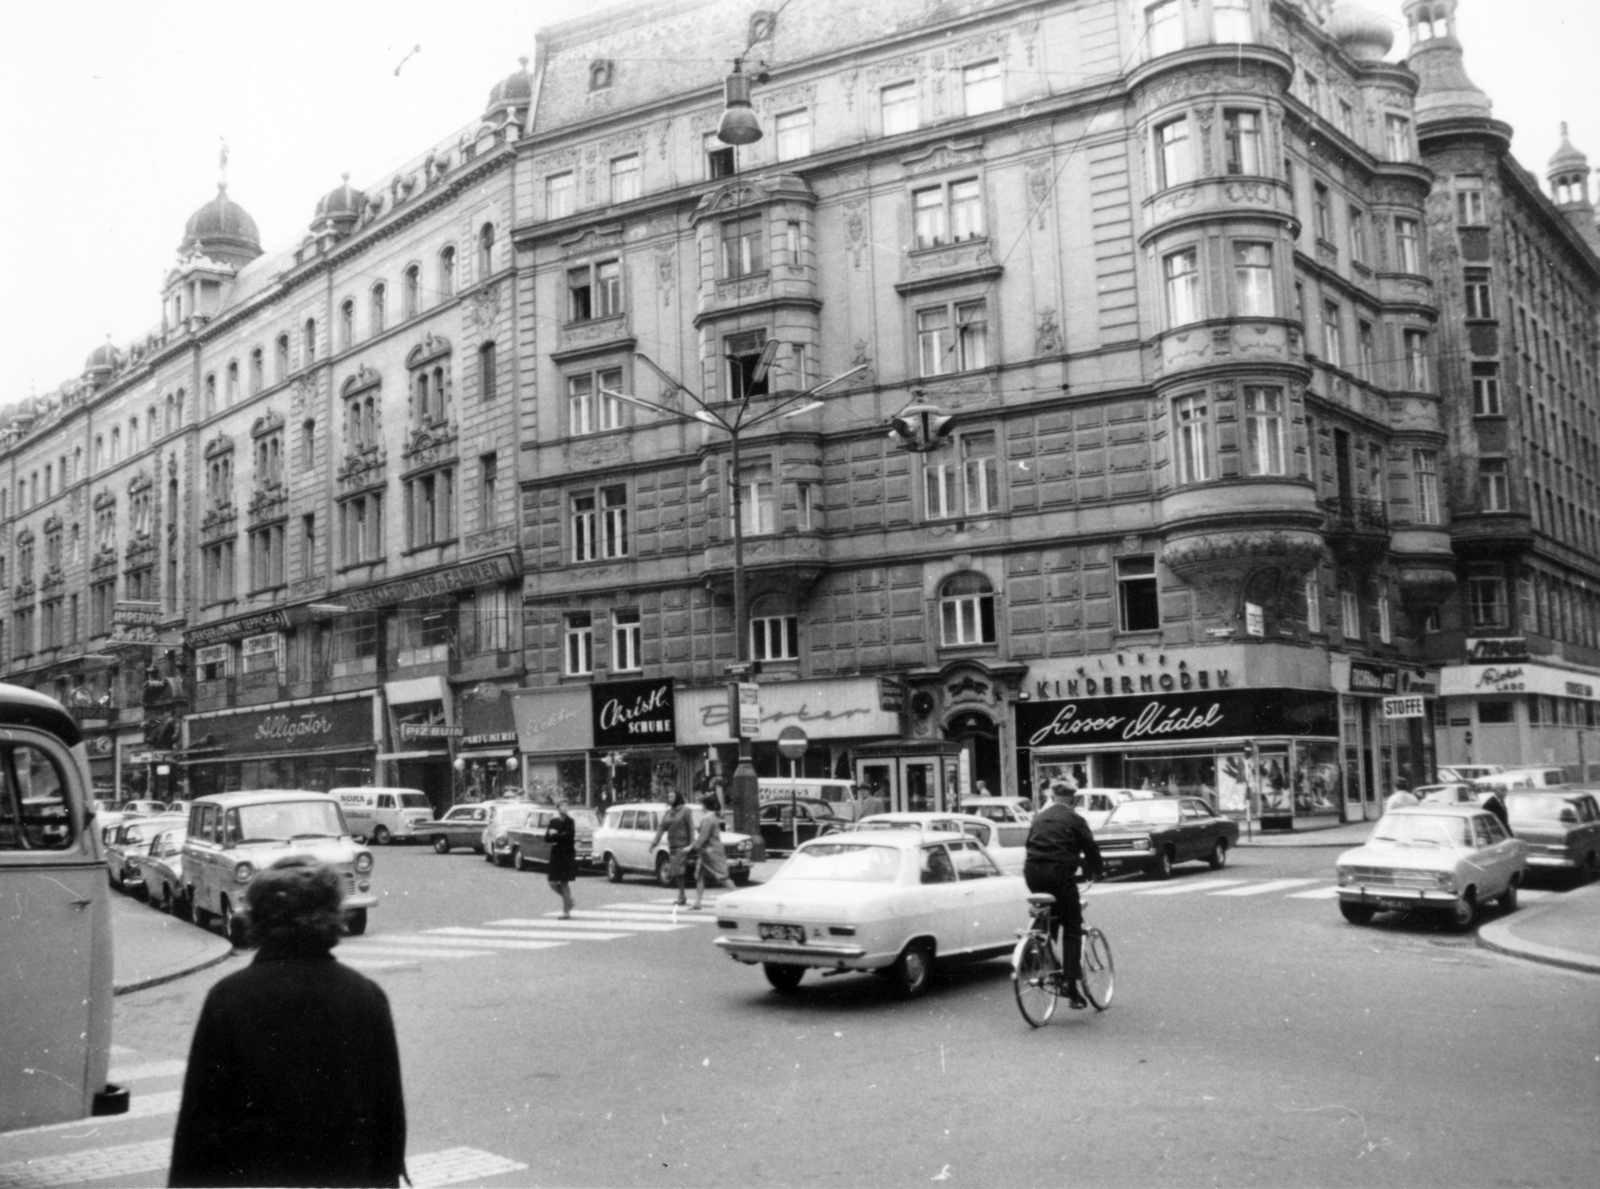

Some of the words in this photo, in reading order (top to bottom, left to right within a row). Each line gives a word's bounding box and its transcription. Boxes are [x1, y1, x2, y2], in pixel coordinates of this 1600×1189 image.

[1037, 669, 1230, 699] KINDERMODEN
[1385, 698, 1423, 716] STOFFE
[254, 711, 333, 743] Alligator
[406, 727, 428, 736] PIZ
[431, 727, 464, 736] BUIN
[628, 719, 671, 734] SCHUHE
